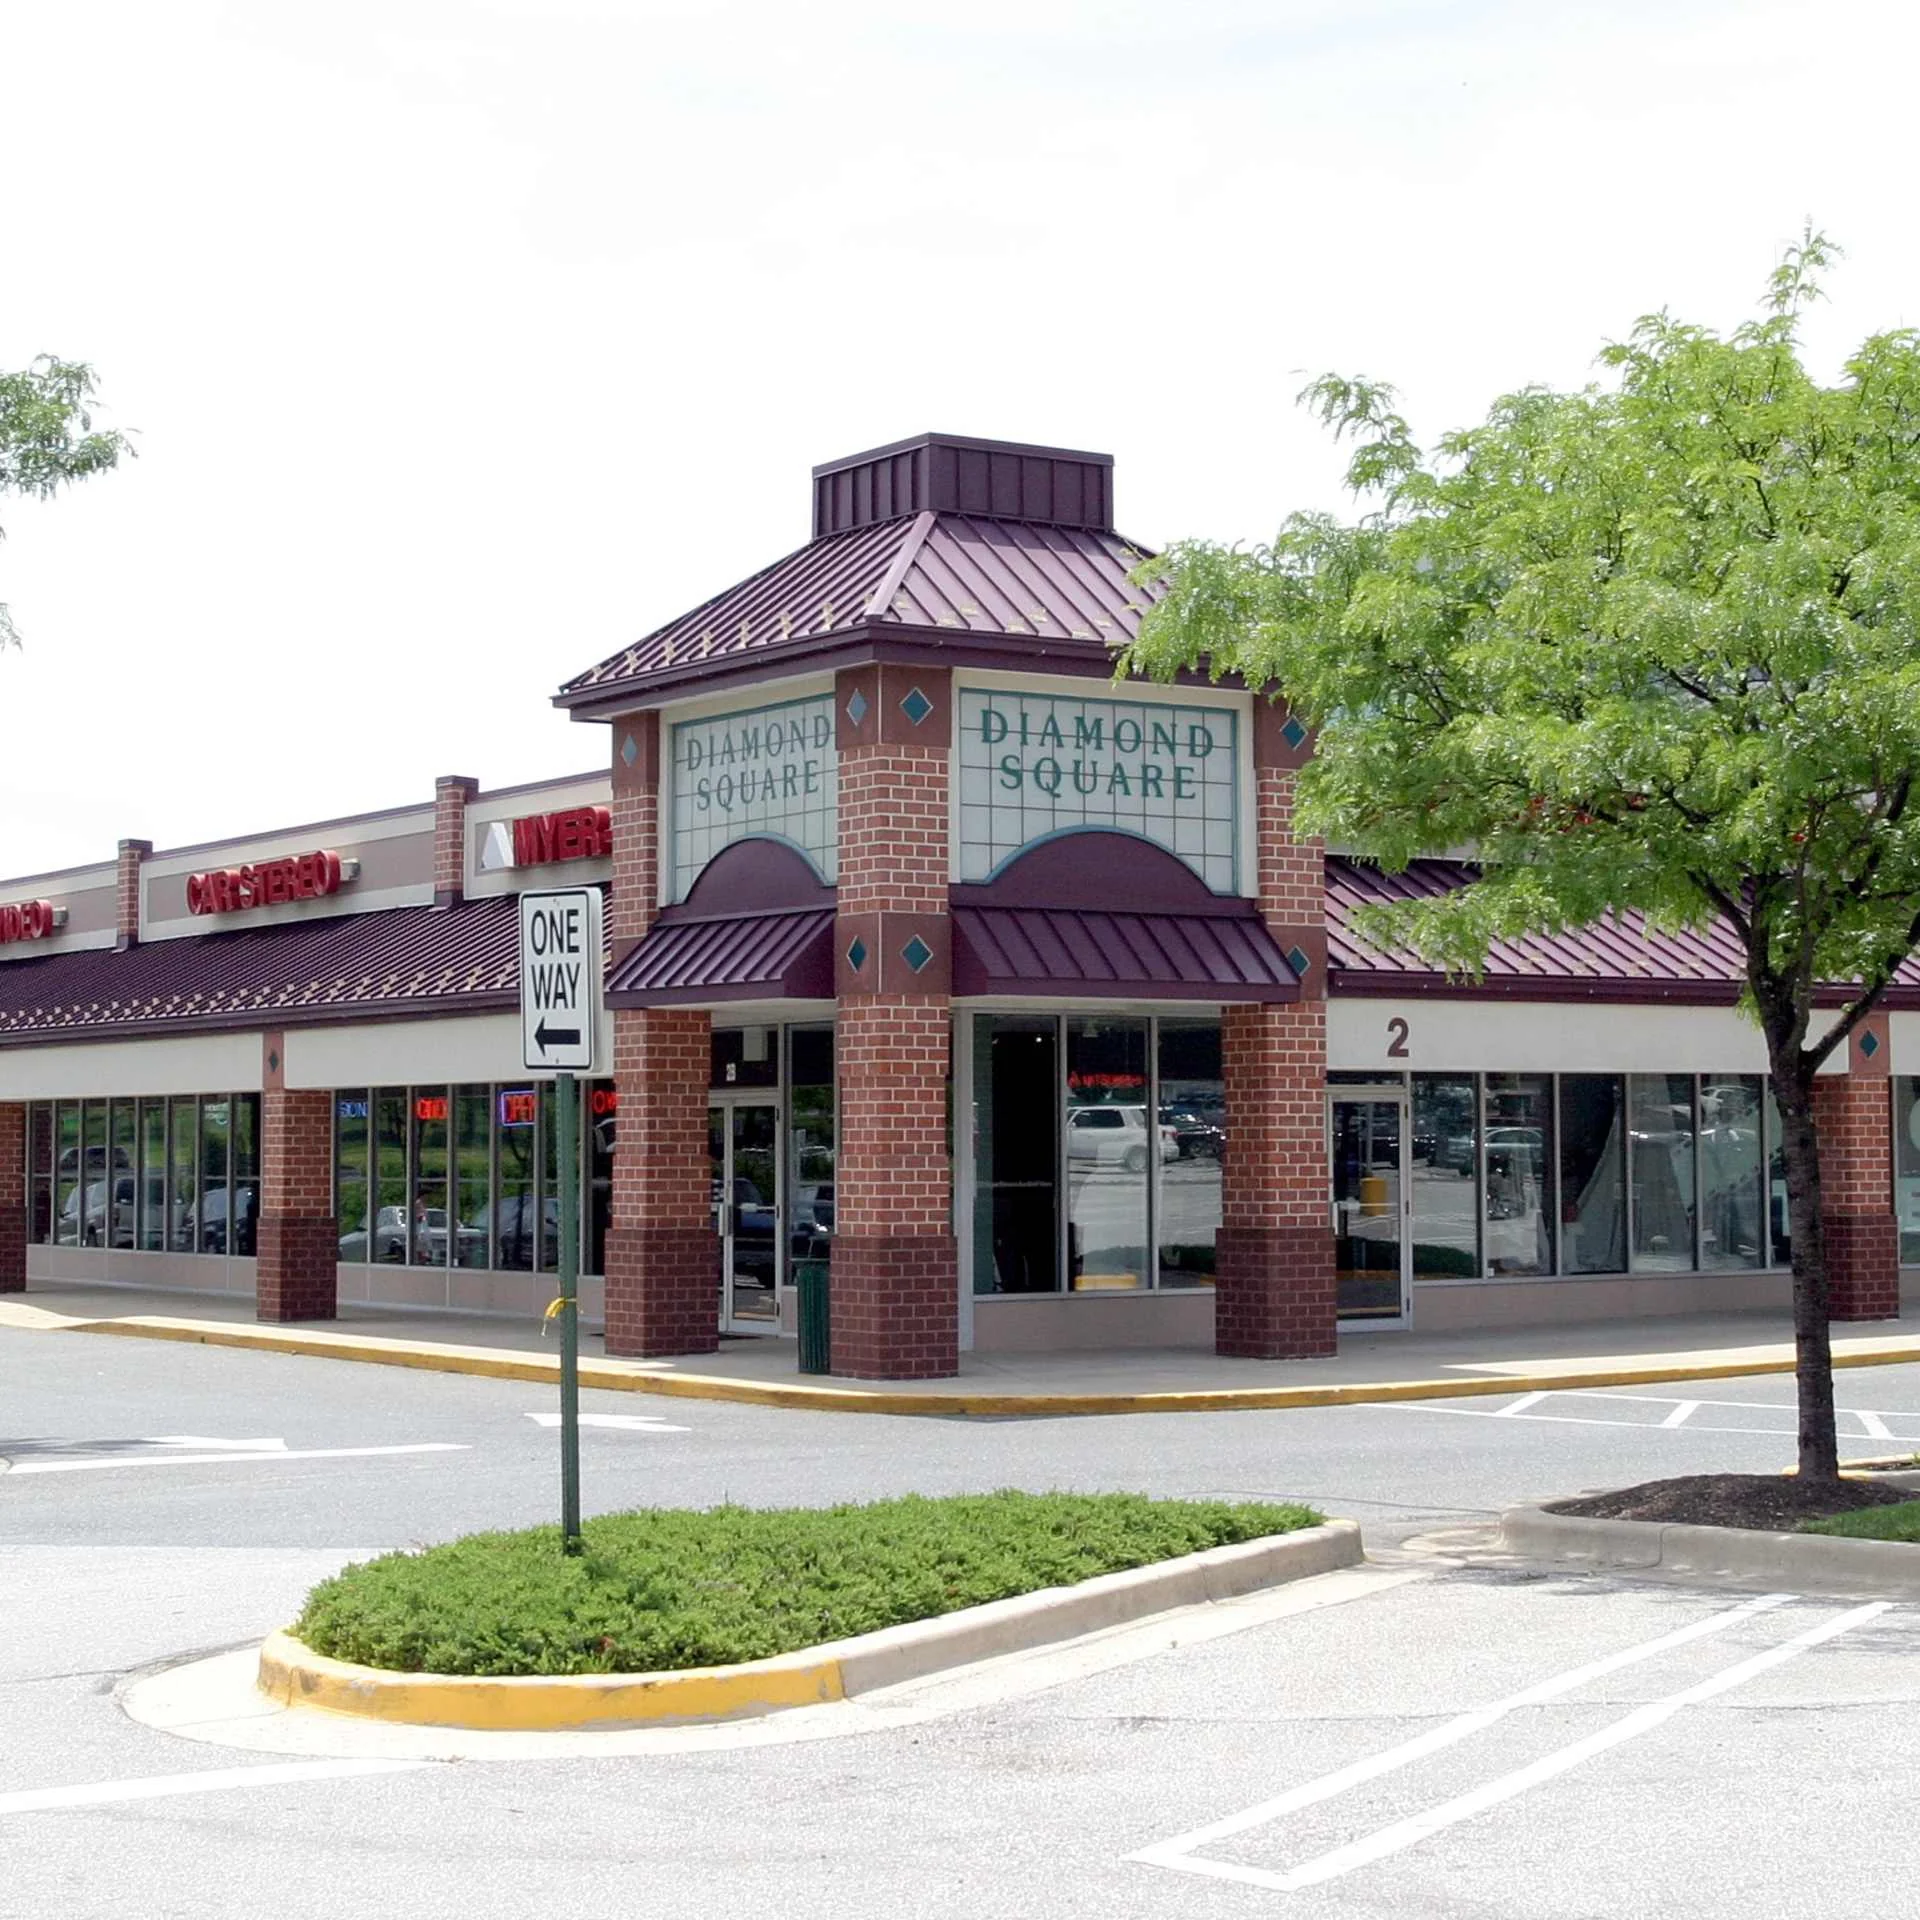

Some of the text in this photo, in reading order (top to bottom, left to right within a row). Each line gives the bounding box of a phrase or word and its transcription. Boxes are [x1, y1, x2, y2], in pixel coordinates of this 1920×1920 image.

[686, 714, 831, 771] DIAMOND
[980, 708, 1215, 759] DIAMOND
[696, 759, 819, 812] SQUARE
[999, 753, 1197, 800] SQUARE
[187, 849, 341, 915] CAR STEREO
[530, 908, 580, 956] ONE
[530, 961, 581, 1011] WAY
[1386, 1016, 1410, 1058] 2
